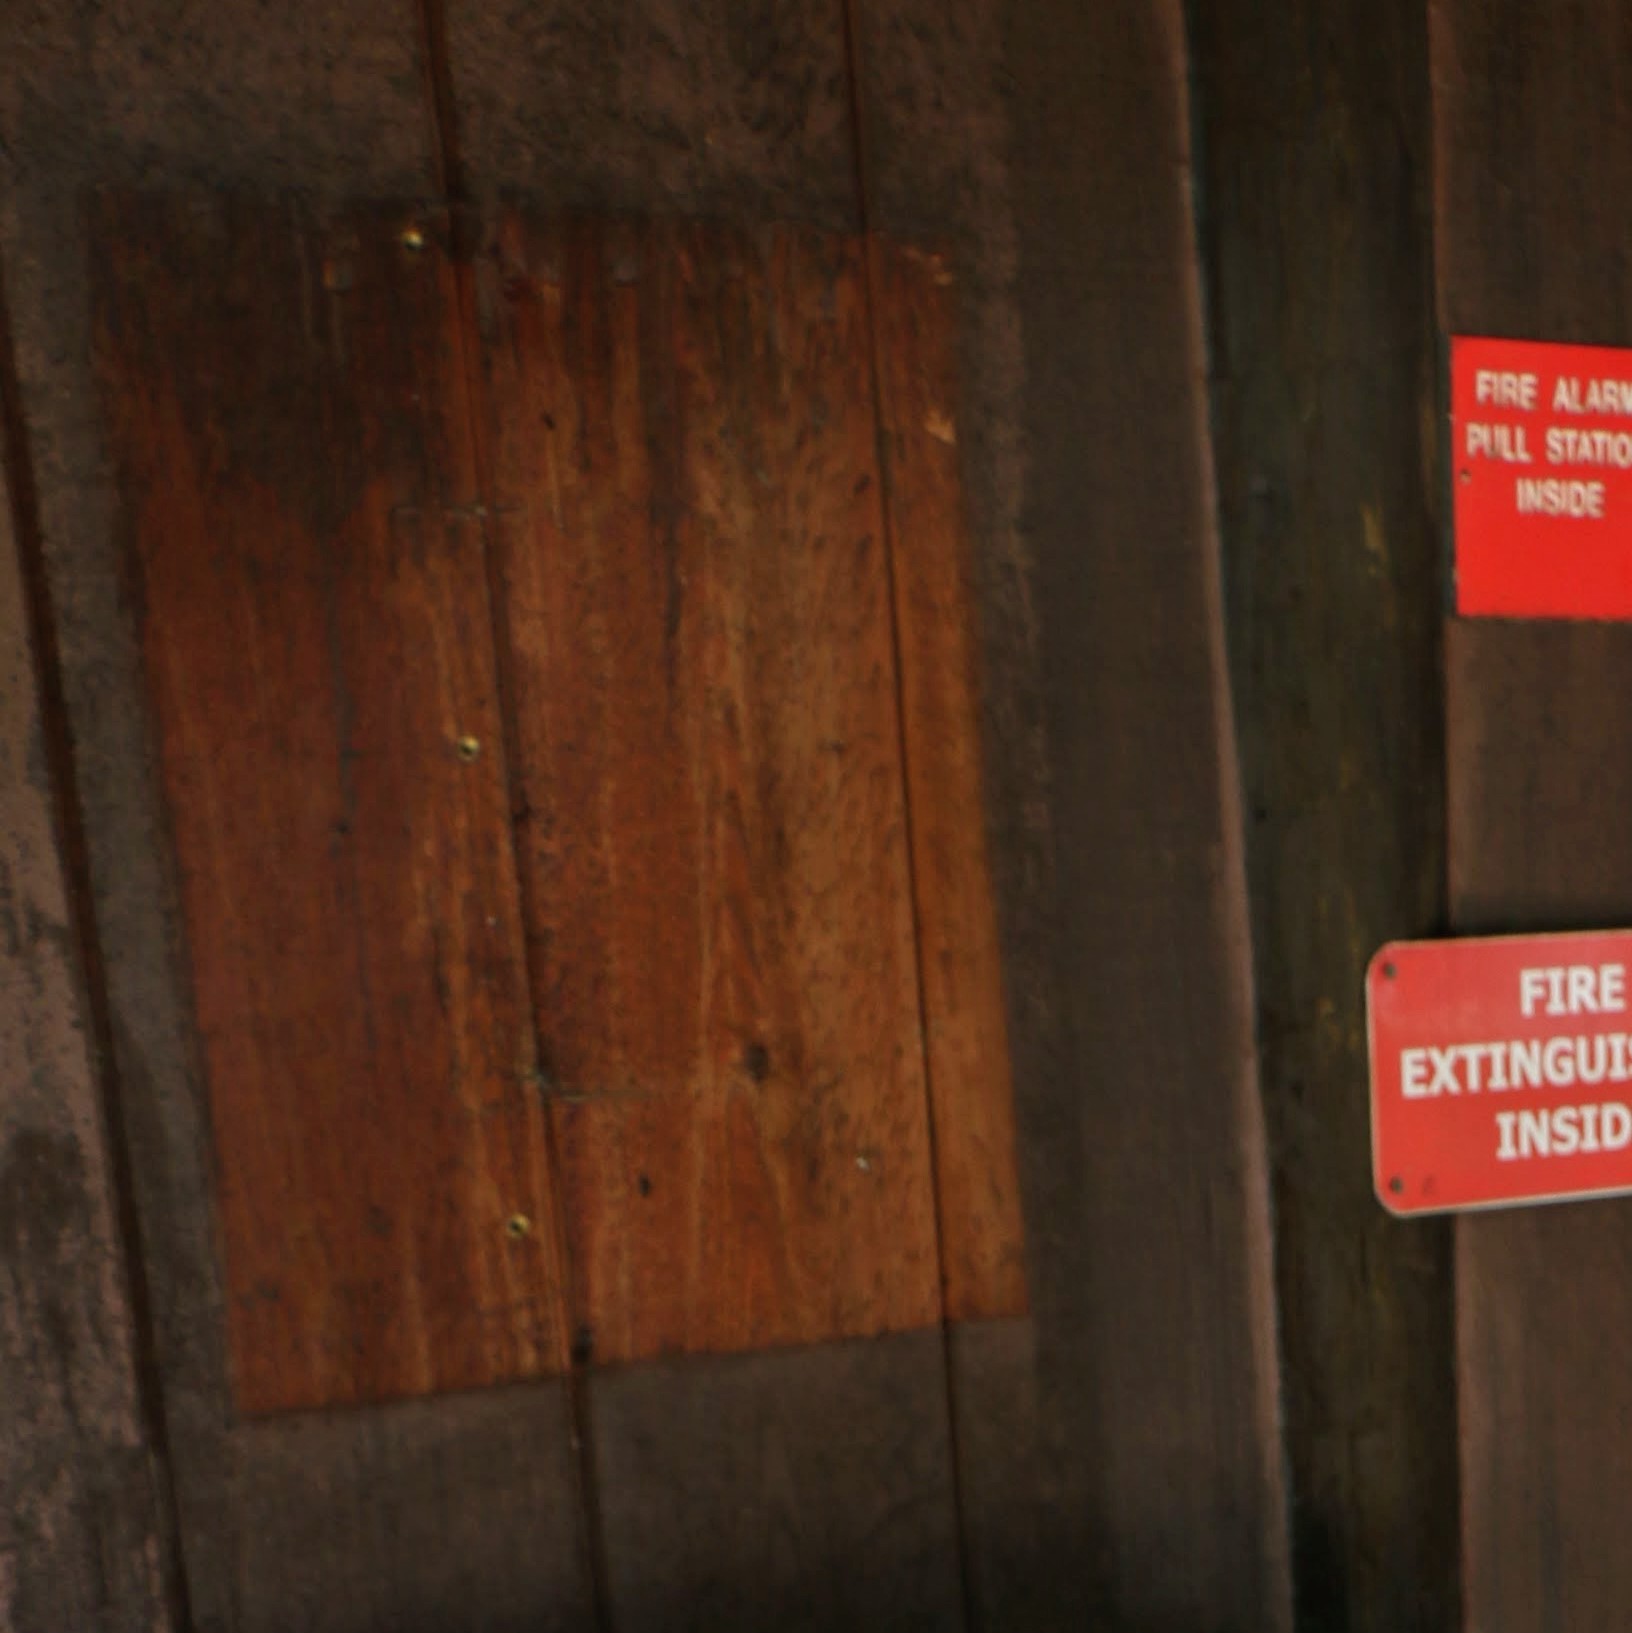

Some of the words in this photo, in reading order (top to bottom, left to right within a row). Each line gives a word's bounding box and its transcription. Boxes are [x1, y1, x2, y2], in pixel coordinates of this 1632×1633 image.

[1475, 370, 1539, 410] FIRE
[1465, 422, 1532, 464] PULL
[1515, 478, 1605, 519] INSIDE
[1519, 963, 1627, 1018] FIRE
